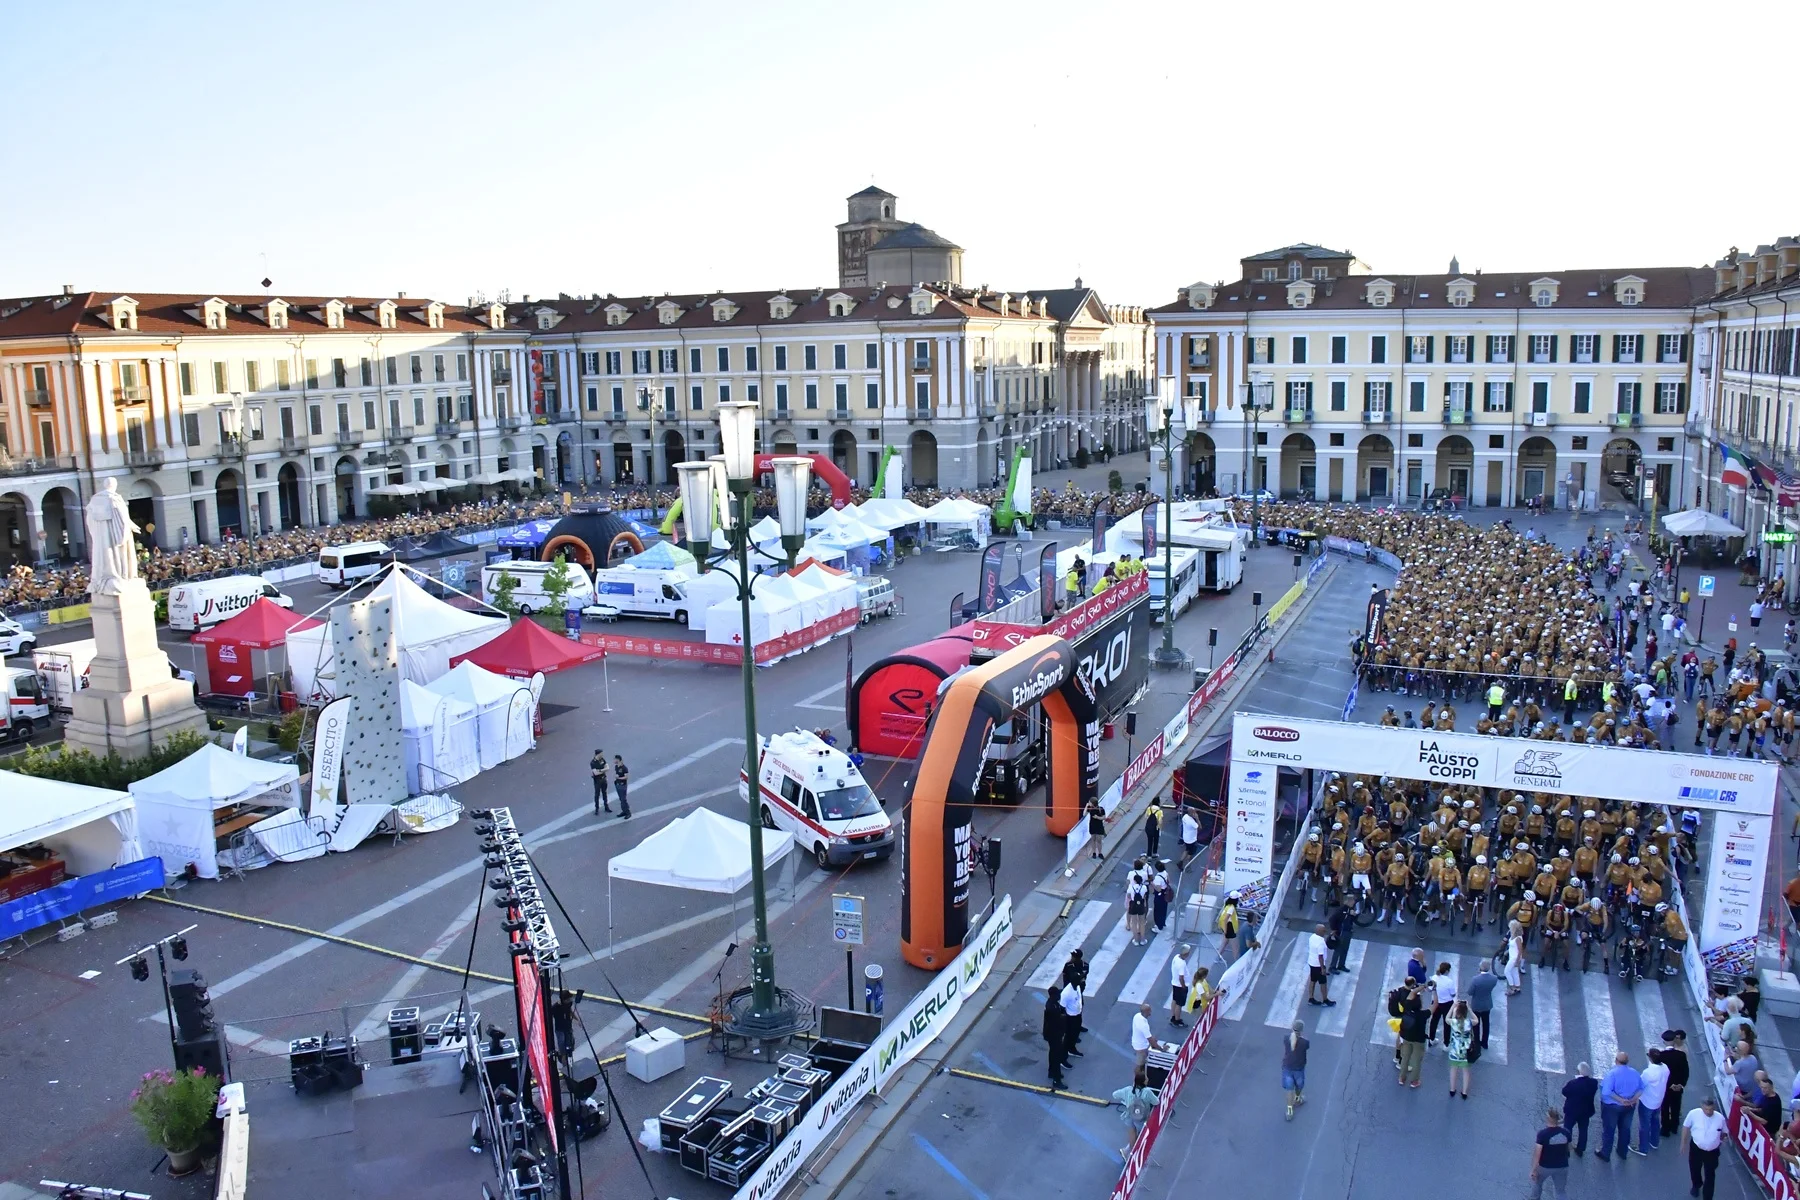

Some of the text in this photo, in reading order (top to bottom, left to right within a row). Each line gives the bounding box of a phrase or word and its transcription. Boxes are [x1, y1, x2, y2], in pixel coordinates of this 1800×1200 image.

[1702, 577, 1713, 589] P
[215, 589, 264, 613] vittori
[1011, 663, 1064, 711] EthicSport
[1254, 728, 1299, 740] BALOCCO
[321, 717, 338, 781] ESERCITO
[1420, 740, 1439, 752] LA
[972, 722, 996, 796] EthicSport
[1260, 751, 1302, 761] MERLO
[1419, 752, 1479, 768] FAUSTO
[1126, 738, 1163, 791] BALOCCO
[1429, 765, 1476, 780] COPPI
[1513, 776, 1561, 789] GENERALI
[1690, 768, 1755, 783] FONDAZIONE CRC
[1690, 787, 1719, 801] BANCA
[1719, 790, 1738, 802] CRS
[900, 975, 958, 1050] MERLO
[830, 1066, 870, 1116] vittoria
[757, 1139, 802, 1198] vittoria
